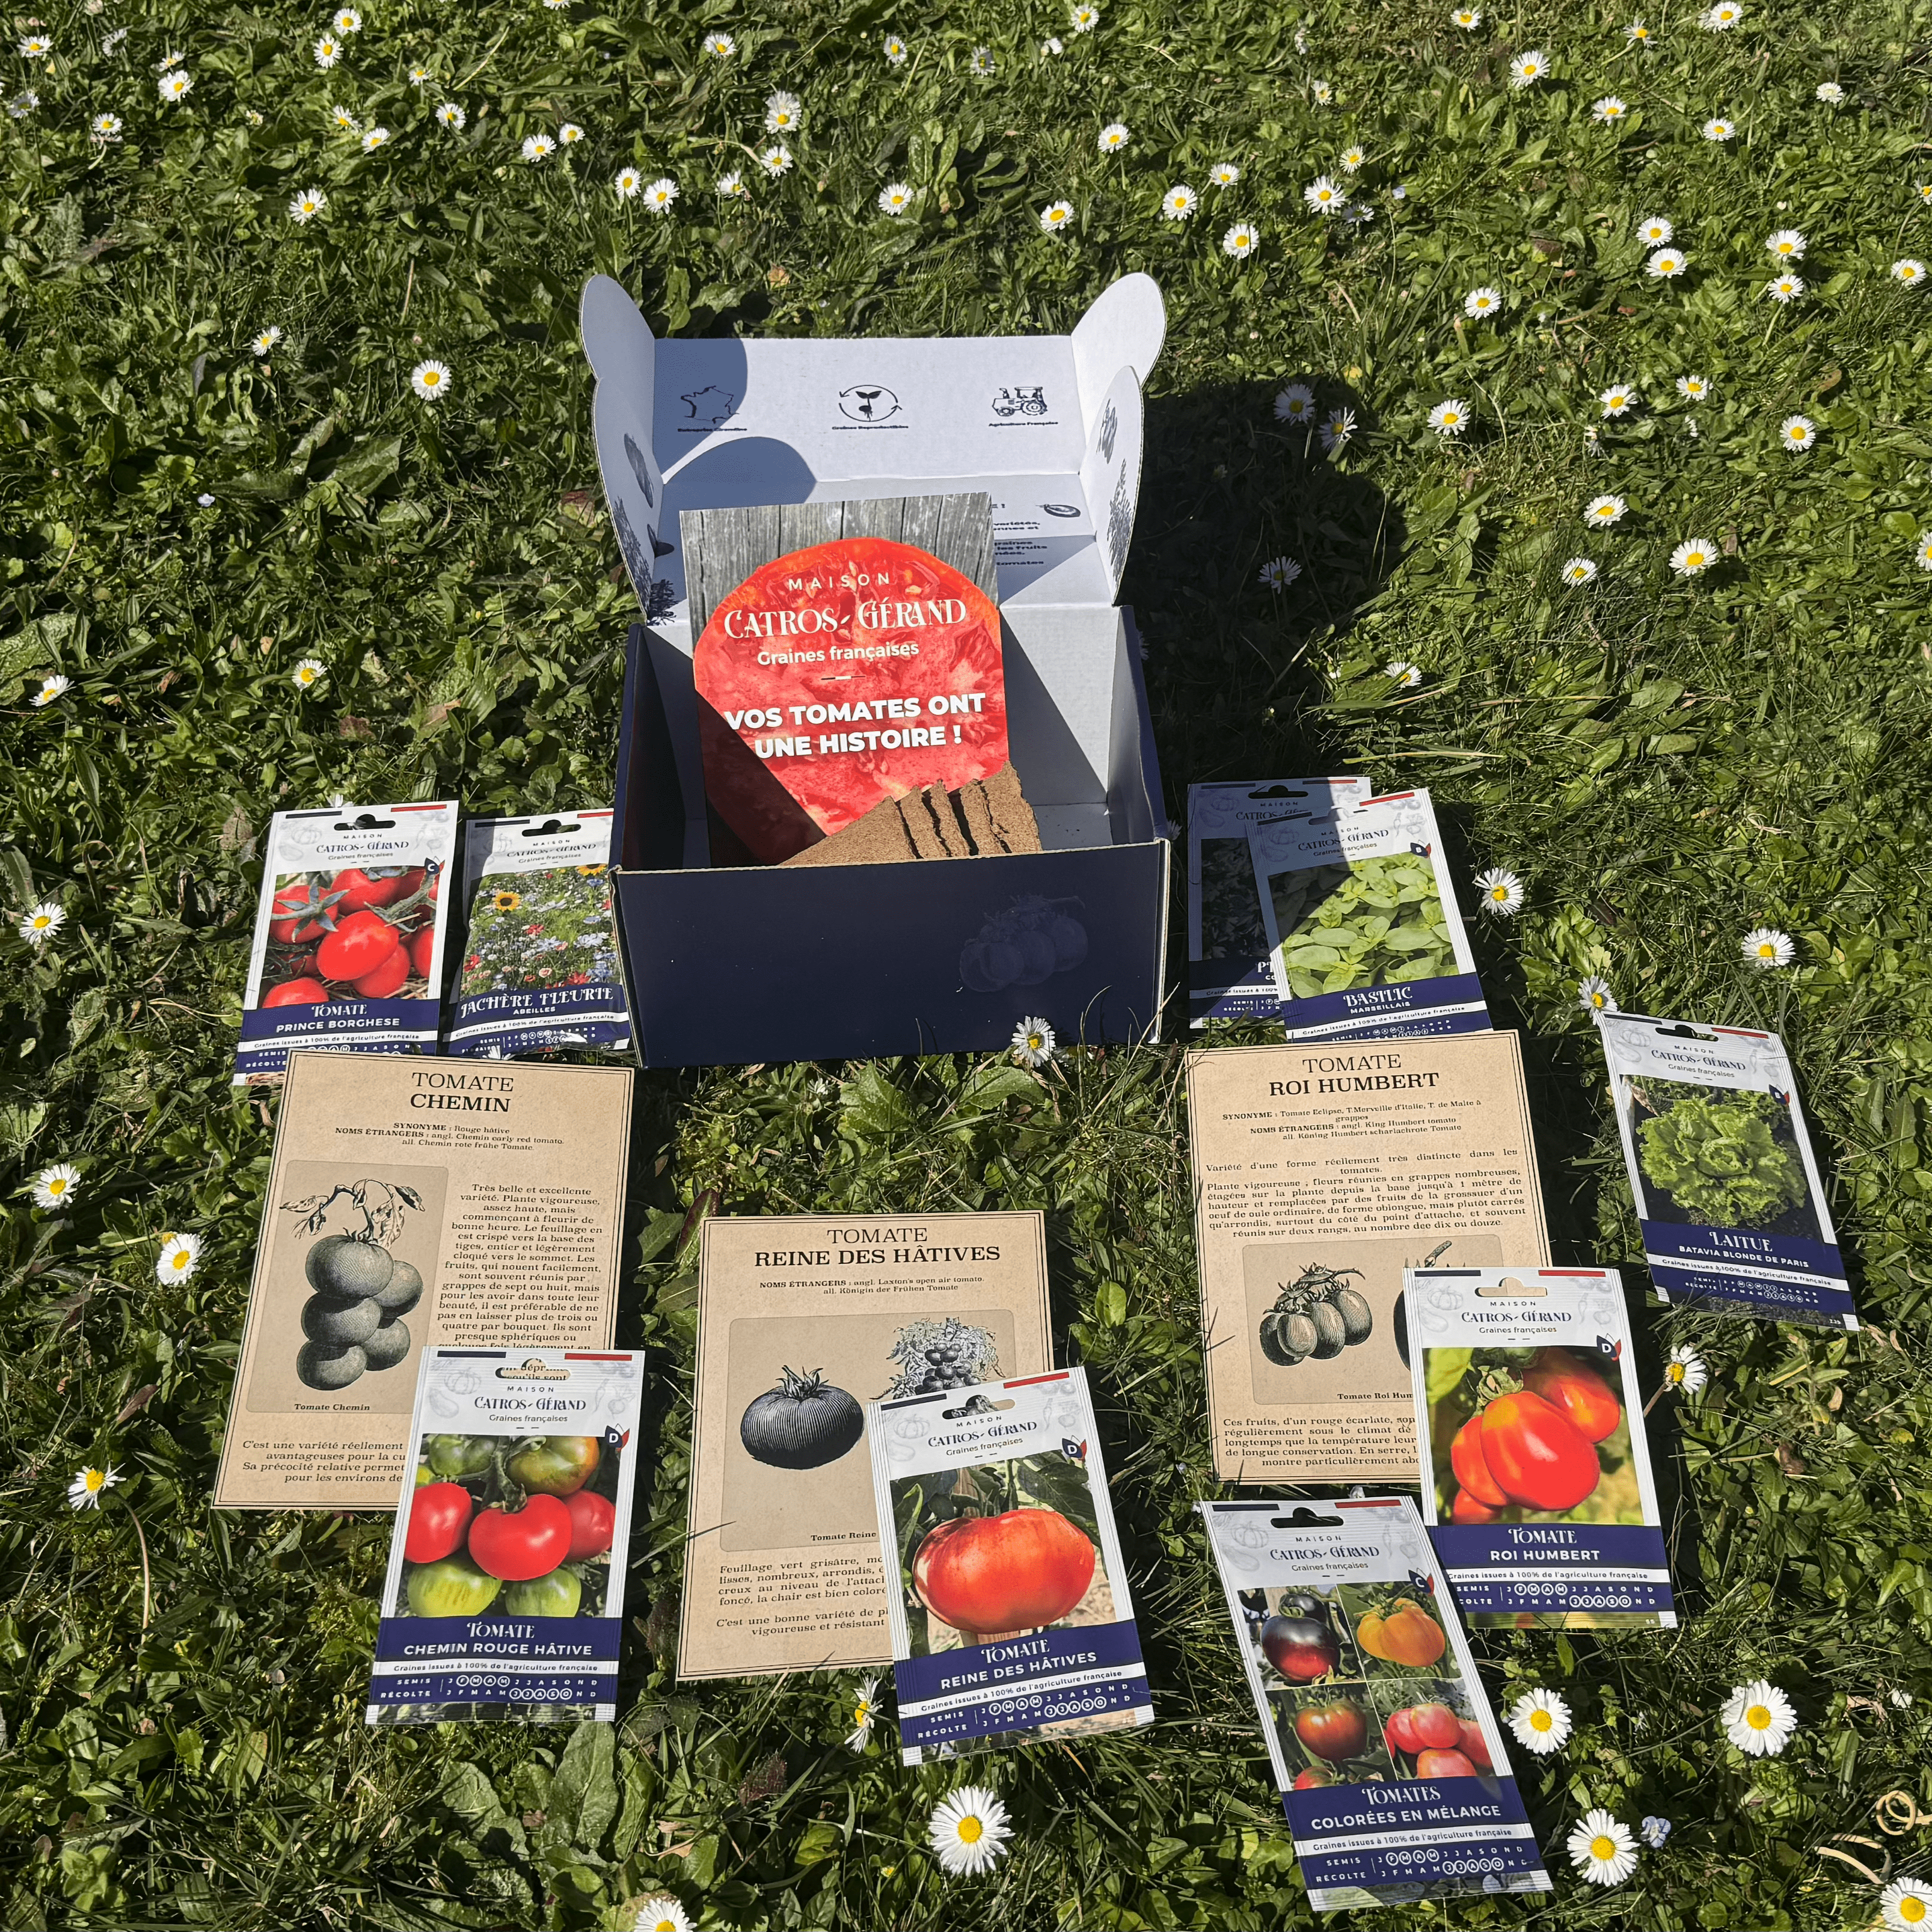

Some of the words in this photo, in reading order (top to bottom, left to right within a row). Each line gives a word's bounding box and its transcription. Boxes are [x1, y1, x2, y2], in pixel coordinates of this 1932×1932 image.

[788, 574, 890, 591] MAISON
[758, 651, 826, 666] Graines
[829, 642, 919, 663] françaises
[723, 709, 782, 731] VOS
[789, 697, 921, 726] TOMATES
[928, 693, 986, 714] ONT
[755, 737, 811, 759] UNE
[819, 726, 946, 754] HISTOIRE
[461, 993, 533, 1018] JACHÈRE
[539, 987, 613, 1005] FLEURIE
[1343, 986, 1412, 1007] BASILIC
[311, 1004, 367, 1017] TOMATE
[512, 1006, 556, 1014] ABEILLES
[1350, 1001, 1411, 1014] MARSEILLAIS
[275, 1021, 324, 1032] PRINCE
[328, 1017, 400, 1028] BORGHESE
[1673, 1045, 1714, 1054] MAISON
[1302, 1053, 1401, 1073] TOMATE
[1667, 1063, 1696, 1072] Graines
[1697, 1067, 1735, 1078] françaises
[411, 1072, 514, 1091] TOMATE
[1269, 1079, 1310, 1096] ROI
[1317, 1072, 1439, 1093] HUMBERT
[410, 1093, 511, 1112] CHEMIN
[393, 1122, 446, 1130] SYNONYME
[454, 1125, 481, 1133] Rouge
[503, 1194, 536, 1203] Plante
[539, 1186, 591, 1195] excellente
[826, 1227, 927, 1244] TOMATE
[1708, 1231, 1773, 1251] LAITUE
[755, 1251, 830, 1266] REINE
[838, 1249, 885, 1264] DES
[893, 1246, 1000, 1263] HÂTIVES
[1679, 1245, 1720, 1256] BATAVIA
[1722, 1250, 1762, 1261] BLONDE
[1780, 1257, 1809, 1267] PARIS
[1513, 1326, 1557, 1334] françaises
[1602, 1343, 1612, 1353] D
[956, 1415, 1002, 1427] MAISON
[298, 1441, 338, 1449] variété
[609, 1434, 619, 1443] D
[945, 1446, 978, 1455] Graines
[980, 1438, 1023, 1450] françaises
[1225, 1438, 1282, 1447] longtemps
[1322, 1437, 1390, 1446] température
[1068, 1446, 1078, 1455] D
[1507, 1527, 1577, 1544] TOMATE
[1490, 1550, 1517, 1560] ROI
[1523, 1550, 1599, 1560] HUMBERT
[720, 1563, 772, 1573] Feuillage
[1415, 1577, 1421, 1587] C
[466, 1621, 535, 1638] TOMATE
[752, 1625, 816, 1636] vigoureuse
[834, 1619, 884, 1629] résistant
[403, 1643, 467, 1655] CHEMIN
[473, 1643, 529, 1654] ROUGE
[534, 1642, 592, 1655] HÂTIVE
[980, 1639, 1050, 1663] TOMATE
[940, 1670, 989, 1689] REINE
[993, 1664, 1024, 1678] DES
[1029, 1652, 1096, 1672] HÂTIVES
[921, 1699, 953, 1711] Graines
[954, 1694, 981, 1705] issues
[990, 1687, 1014, 1698] 100%
[1028, 1676, 1081, 1691] l'agriculture
[1084, 1670, 1123, 1683] française
[930, 1711, 963, 1723] SEMIS
[918, 1724, 967, 1738] RÉCOLTE
[1361, 1786, 1441, 1805] TOMATES
[1311, 1810, 1396, 1829] COLORÉES
[1400, 1809, 1423, 1821] EN
[1426, 1805, 1501, 1820] MÉLANGE
[1313, 1842, 1346, 1850] Graines
[1384, 1835, 1407, 1844] 100%
[1421, 1830, 1473, 1842] l'agriculture
[1475, 1828, 1512, 1838] française
[1326, 1857, 1360, 1866] SEMIS
[1315, 1871, 1366, 1882] RÉCOLTE
